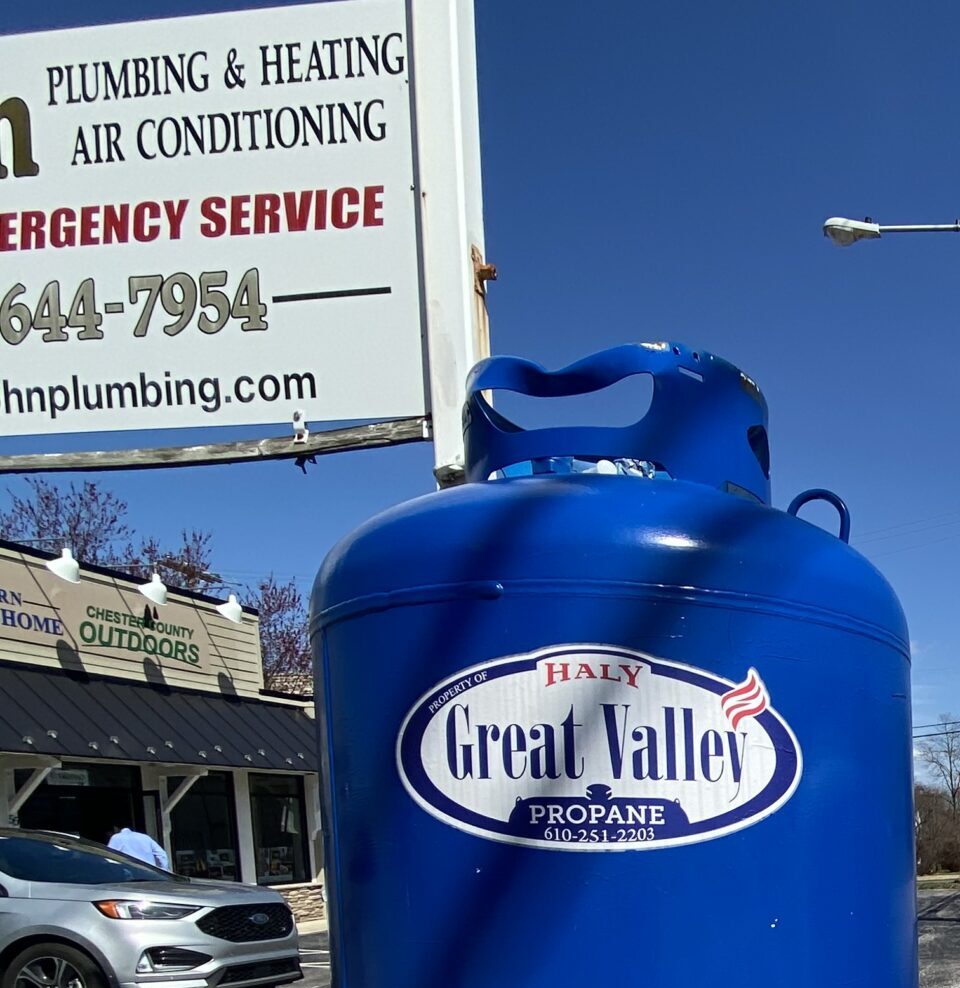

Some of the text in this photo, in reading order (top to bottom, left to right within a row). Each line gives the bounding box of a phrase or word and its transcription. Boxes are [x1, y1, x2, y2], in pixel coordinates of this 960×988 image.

[47, 32, 405, 106] PLUMBING & HEATING
[71, 98, 388, 166] AIR CONDITIONING
[0, 184, 386, 252] ERGENCY SERVICE
[0, 267, 269, 346] 644-7954
[2, 370, 318, 420] hnplumbing.com
[0, 607, 64, 636] HOME
[79, 620, 200, 664] OUTDOORS
[86, 605, 195, 640] CHESTER COUNTY
[428, 670, 488, 713] PROPERTY OF
[544, 661, 645, 690] HALY
[445, 702, 748, 803] Great Valley
[528, 803, 666, 825] PROPANE
[543, 825, 656, 843] 610-251-2203
